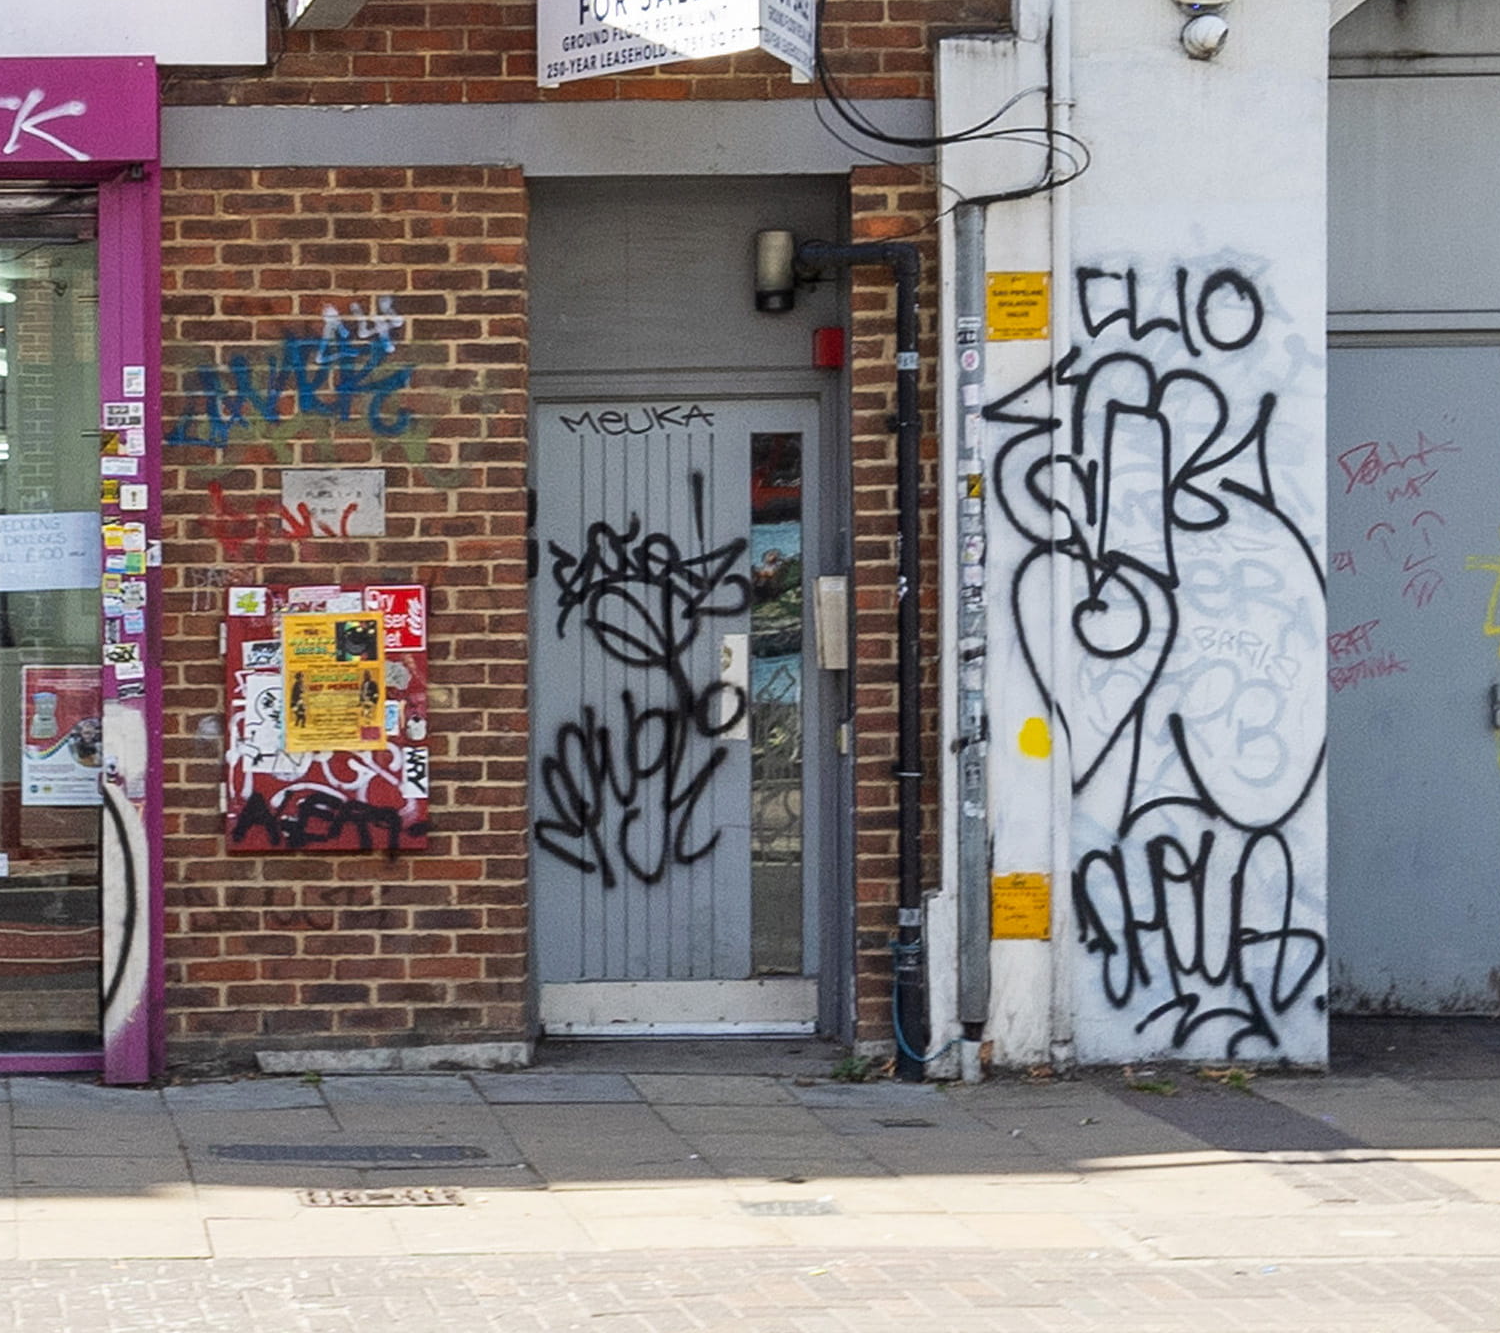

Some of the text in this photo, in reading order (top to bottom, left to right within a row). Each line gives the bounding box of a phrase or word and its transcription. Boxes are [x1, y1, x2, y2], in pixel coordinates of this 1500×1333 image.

[562, 31, 610, 52] GROUND
[546, 60, 597, 79] 250-YEAR
[600, 44, 667, 69] LEASEHOLD
